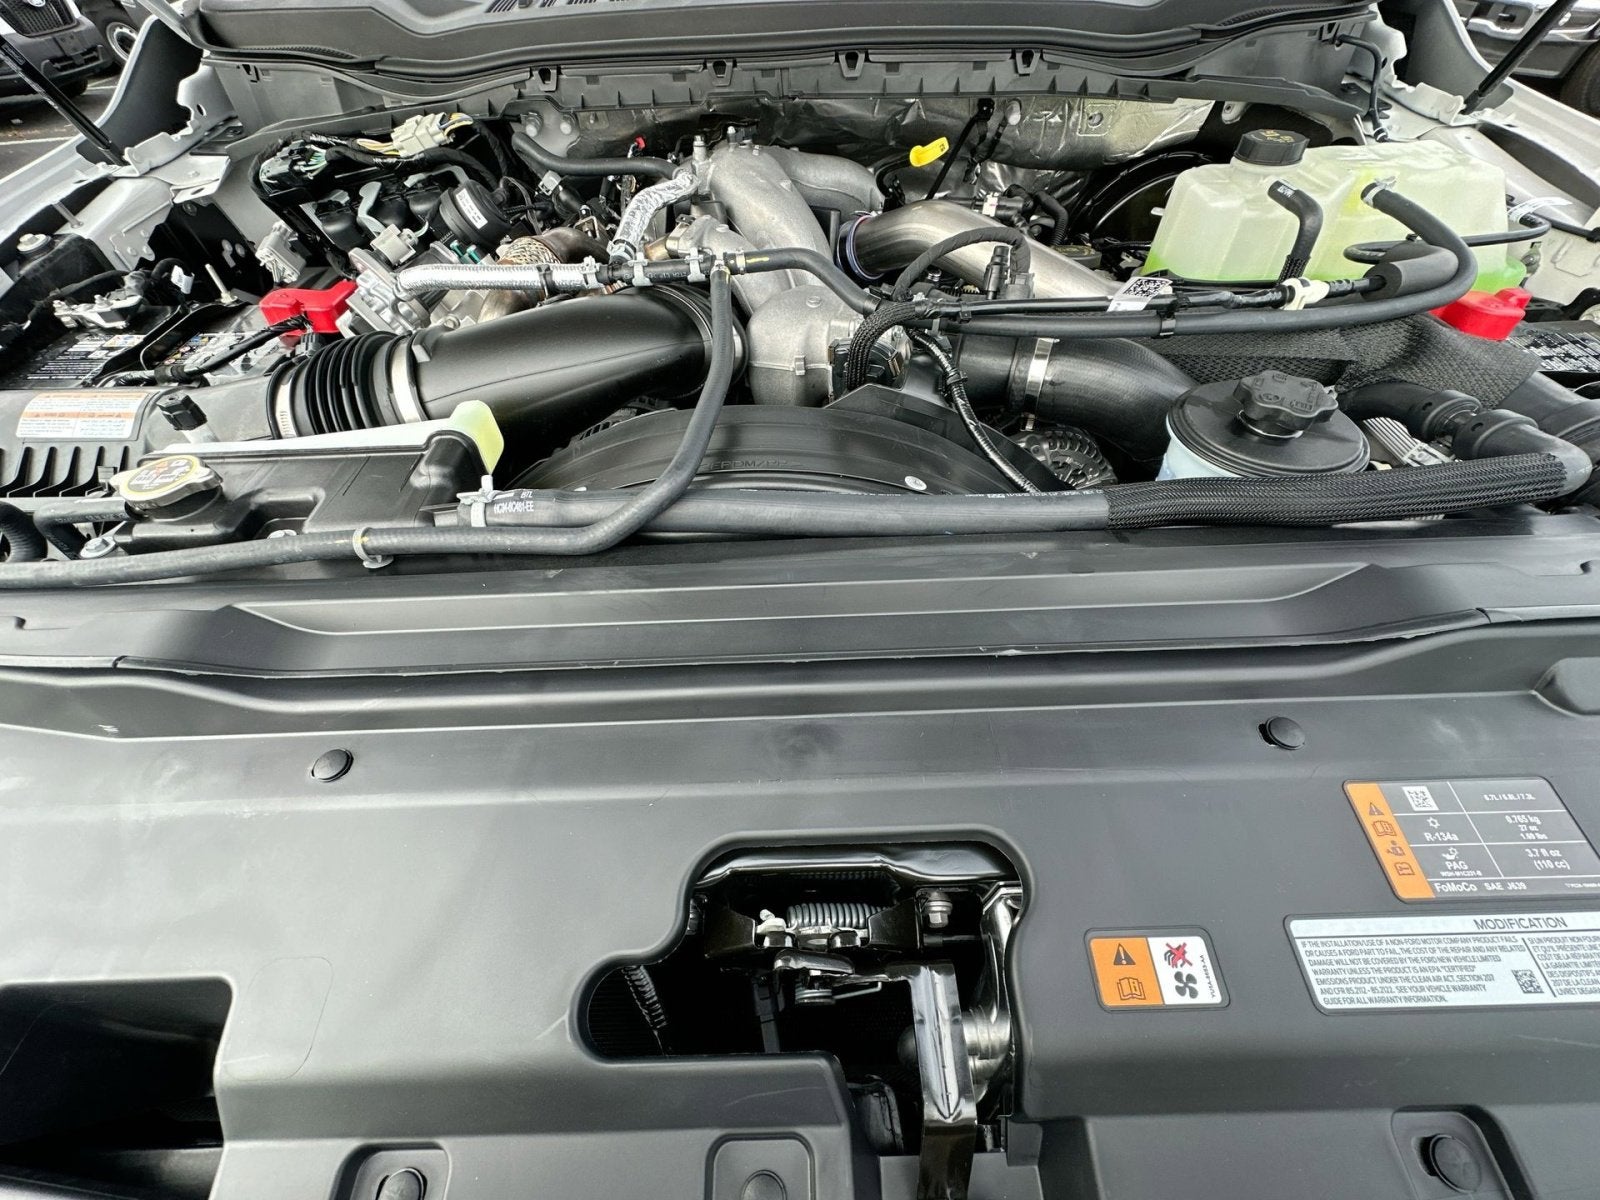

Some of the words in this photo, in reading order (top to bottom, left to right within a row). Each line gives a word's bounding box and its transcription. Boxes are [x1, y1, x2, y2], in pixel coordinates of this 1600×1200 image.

[1505, 814, 1529, 824] 0.765
[1528, 814, 1542, 824] kg
[1423, 832, 1460, 842] R-134a
[1524, 848, 1540, 858] 3.7
[1445, 860, 1468, 870] PAG
[1533, 858, 1554, 870] (110
[1554, 858, 1571, 870] cc)
[1434, 882, 1478, 892] FoMoCo
[1484, 882, 1504, 891] SAE
[1506, 881, 1528, 890] J639
[1473, 916, 1568, 930] MODIFICATION
[1308, 958, 1334, 966] DAMAGE
[1437, 956, 1452, 964] NEW
[1550, 961, 1580, 969] GARANTIE
[1312, 968, 1348, 976] WARRANTY
[1558, 970, 1595, 978] DISPOSITIFS
[1315, 978, 1349, 986] EMISSIONS
[1348, 976, 1378, 985] PRODUCT
[1376, 976, 1400, 984] UNDER
[1456, 974, 1483, 982] SECTION
[1320, 987, 1334, 995] AND
[1334, 986, 1346, 994] CFR
[1395, 986, 1409, 994] SEE
[1408, 985, 1426, 993] YOUR
[1426, 984, 1452, 992] VEHICLE
[1450, 984, 1487, 992] WARRANTY
[1556, 988, 1578, 996] LIVRET
[1323, 997, 1342, 1005] GUIDE
[1342, 996, 1356, 1004] FOR
[1356, 996, 1368, 1004] ALL
[1367, 996, 1403, 1004] WARRANTY
[1402, 994, 1448, 1004] INFORMATION.
